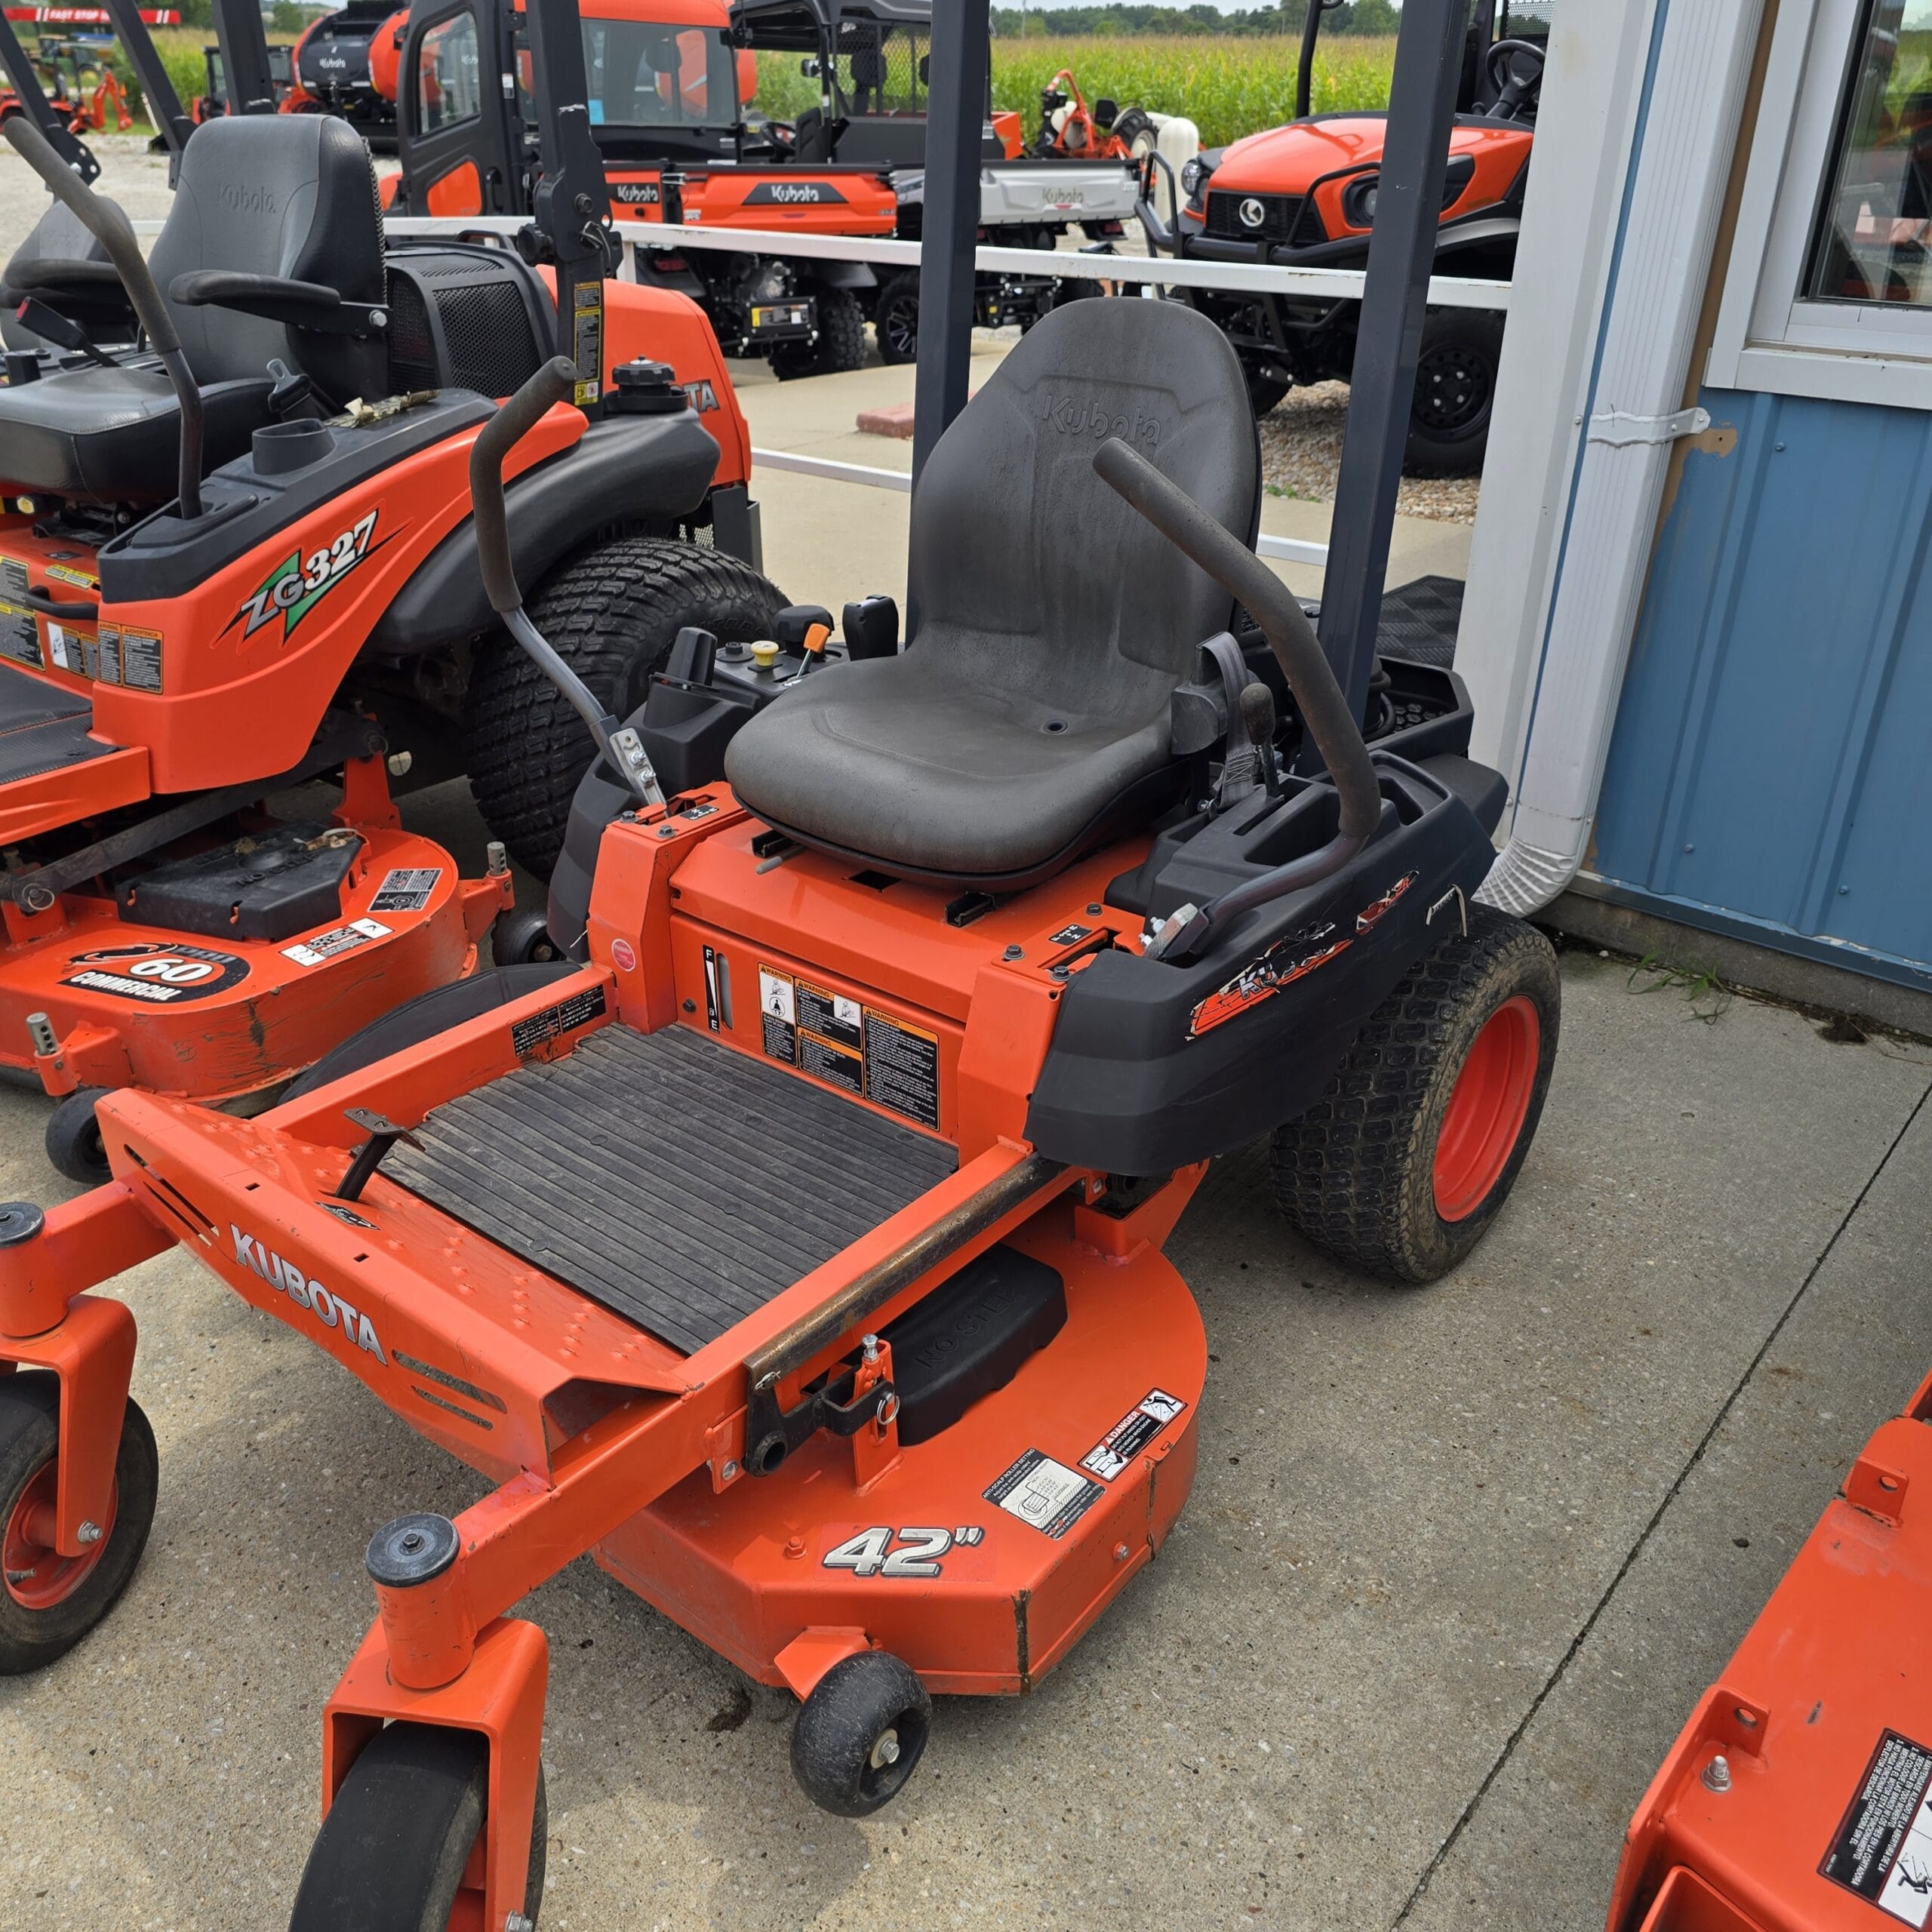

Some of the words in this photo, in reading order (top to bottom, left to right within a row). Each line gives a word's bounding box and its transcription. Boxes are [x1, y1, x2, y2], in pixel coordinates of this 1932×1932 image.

[50, 9, 72, 20] FAST
[74, 11, 99, 20] STOP
[319, 58, 346, 68] Kubota
[217, 183, 276, 215] Kubota
[617, 186, 659, 202] Kubota
[771, 185, 820, 202] Kubota
[1041, 188, 1084, 203] Kubota
[1042, 395, 1161, 445] Kubota
[241, 507, 378, 638] ZG327
[706, 949, 712, 959] F
[129, 958, 214, 983] 60
[766, 967, 792, 982] WARNING
[70, 971, 183, 1001] COMMERCIAL
[802, 983, 829, 998] WARNING
[711, 1020, 718, 1030] E
[871, 1011, 900, 1027] WARNING
[805, 1032, 832, 1048] WARNING
[230, 1223, 387, 1365] KUBOTA
[1112, 1410, 1140, 1438] DANGER
[1002, 1462, 1020, 1478] ROLLER
[1017, 1448, 1035, 1464] SETTING
[992, 1486, 1004, 1497] Adjust
[1876, 1739, 1894, 1768] DEFLECTOR
[1892, 1743, 1902, 1752] NO
[1886, 1750, 1899, 1766] HAGA
[1893, 1747, 1909, 1772] MIENTRAS
[1907, 1751, 1917, 1761] NO
[1872, 1765, 1882, 1775] DE
[1890, 1770, 1900, 1778] EL
[1897, 1758, 1914, 1783] COLOQUE
[1907, 1755, 1925, 1782] DESCARGA
[1874, 1764, 1893, 1793] FUNCIONAR
[1882, 1777, 1897, 1795] MOTOR
[1904, 1780, 1913, 1789] EN
[1893, 1781, 1903, 1792] LAS
[1870, 1790, 1880, 1799] LA
[1885, 1790, 1900, 1810] MANOS
[1897, 1787, 1910, 1803] TODO
[1903, 1790, 1919, 1814] ALEJADO
[1857, 1798, 1877, 1830] CORTADORA
[1872, 1807, 1882, 1817] EN
[1899, 1812, 1909, 1822] DE
[1877, 1814, 1889, 1826] LOS
[1896, 1820, 1906, 1829] LA
[1852, 1828, 1863, 1839] SIN
[1872, 1824, 1884, 1838] PIES
[1848, 1837, 1859, 1846] EL
[1866, 1844, 1875, 1853] LA
[1869, 1836, 1878, 1846] EN
[1884, 1827, 1903, 1857] ABERTURA
[1880, 1854, 1890, 1865] DE
[1850, 1851, 1872, 1886] CORTADORA
[1877, 1863, 1887, 1872] LA
